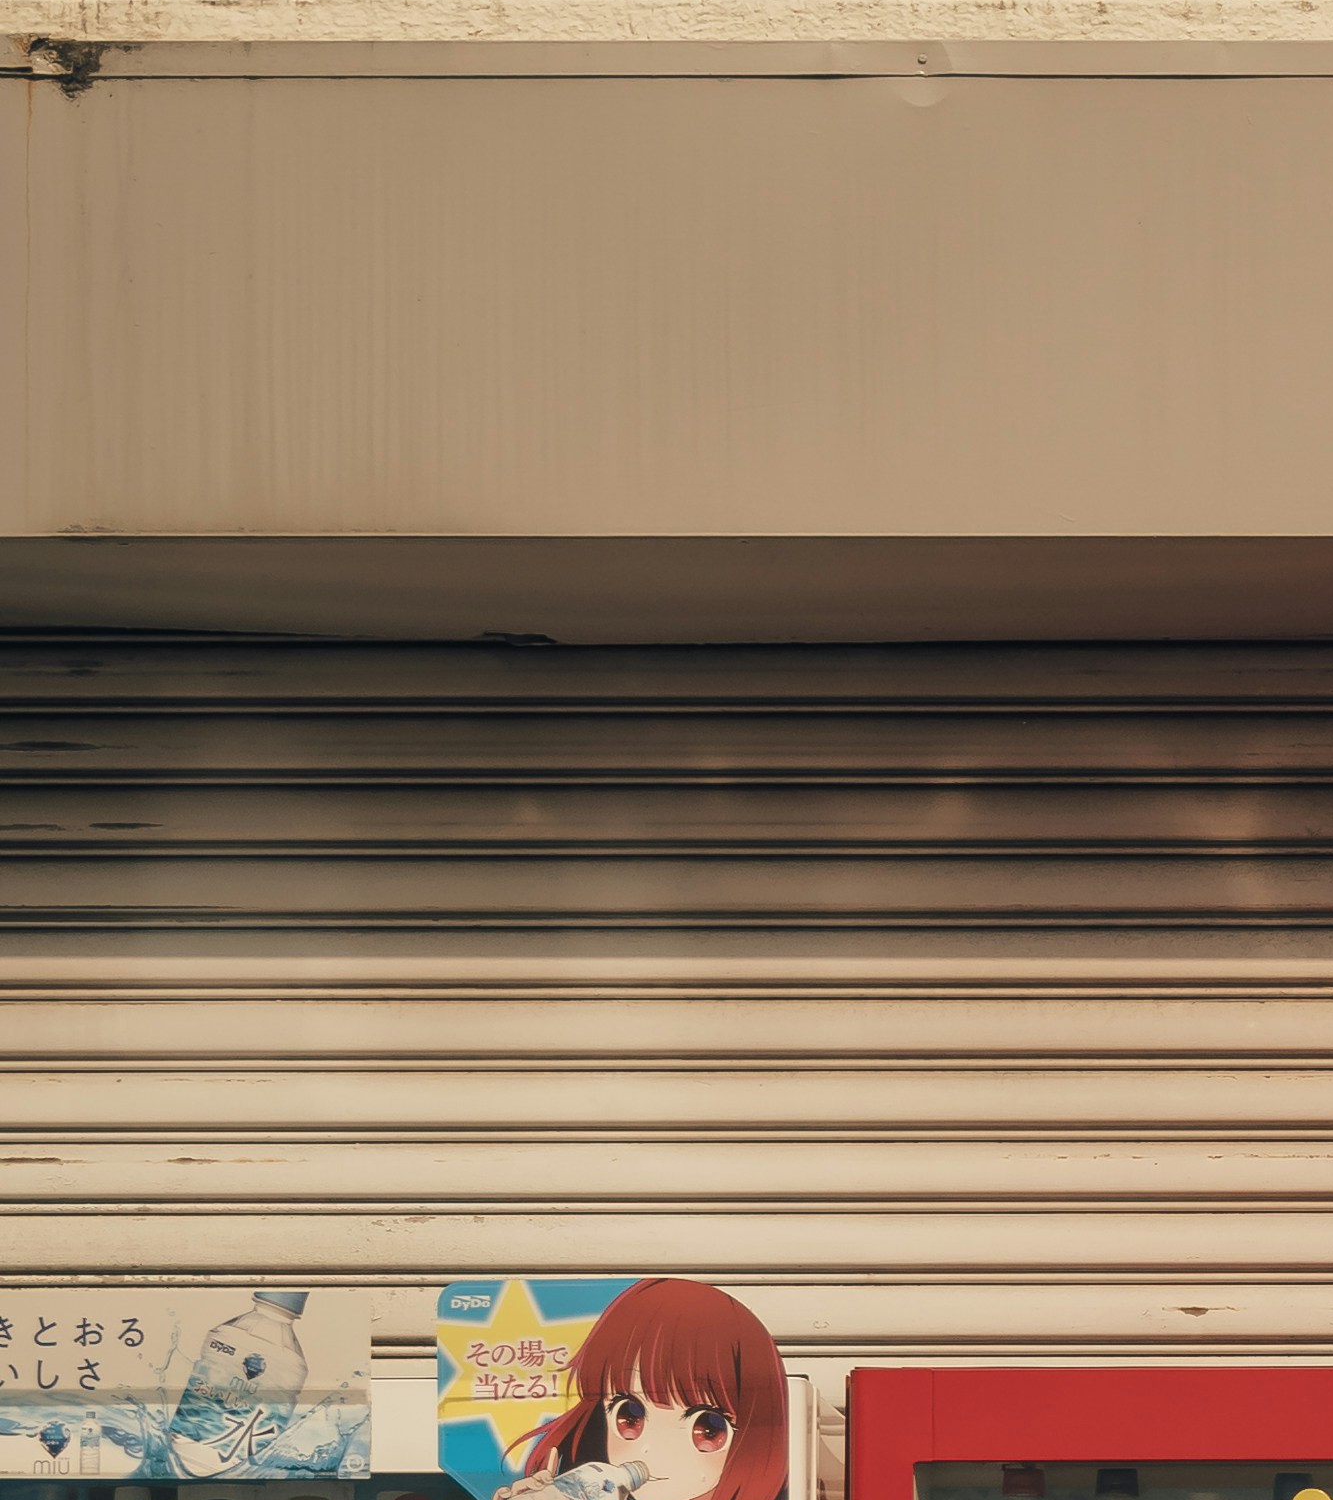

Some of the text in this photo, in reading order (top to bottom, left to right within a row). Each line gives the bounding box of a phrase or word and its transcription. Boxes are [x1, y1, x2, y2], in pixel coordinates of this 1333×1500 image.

[451, 1296, 491, 1310] DyDo
[467, 1340, 567, 1367] その場で
[474, 1374, 558, 1401] 当たる!
[203, 1408, 277, 1464] 水
